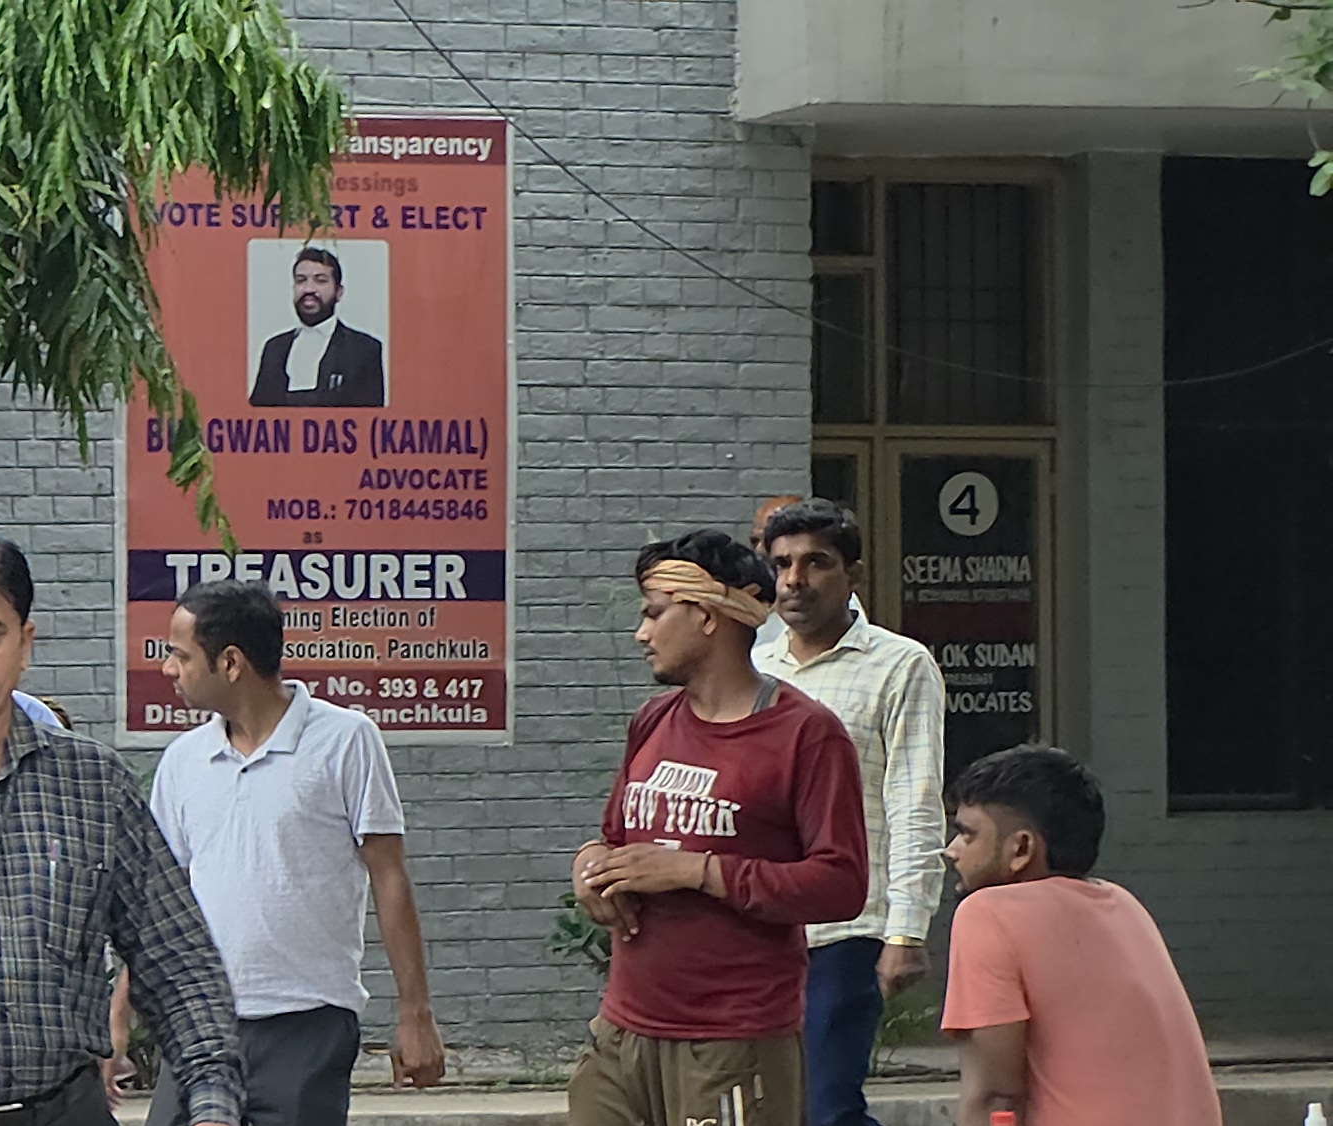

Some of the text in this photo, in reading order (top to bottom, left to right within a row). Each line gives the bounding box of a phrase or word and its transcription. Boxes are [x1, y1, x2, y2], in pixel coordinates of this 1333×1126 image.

[343, 135, 492, 160] ansparency
[232, 203, 360, 229] SUPRT
[372, 205, 389, 228] &
[402, 206, 487, 230] ELECT
[147, 418, 489, 459] BGWAN DAS (KAMAL)
[360, 469, 488, 490] ADVOCATE
[346, 499, 488, 520] 7018445846
[949, 484, 980, 526] 4
[303, 531, 323, 544] as
[903, 555, 1031, 584] SEEMA SHARMA
[332, 607, 409, 627] Election
[418, 607, 436, 627] of
[285, 639, 488, 663] sociation, Panchkula
[974, 643, 1036, 668] SUDAN
[327, 677, 372, 696] No.
[379, 678, 417, 698] 393
[423, 678, 440, 698] &
[445, 679, 483, 699] 417
[946, 691, 1033, 713] VOCATES
[144, 704, 211, 725] Distr
